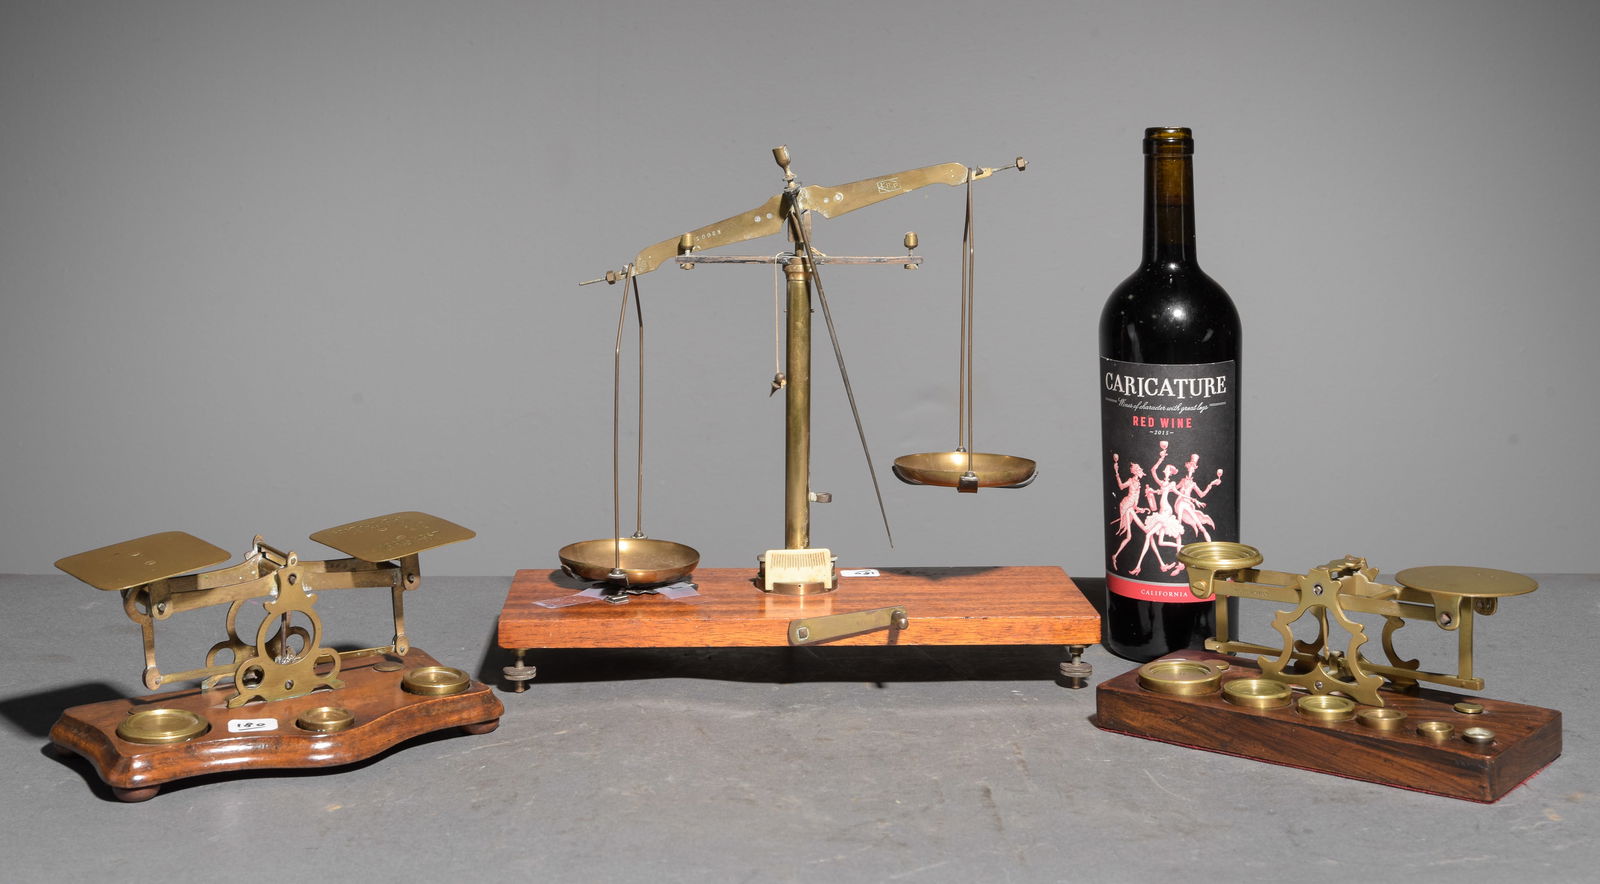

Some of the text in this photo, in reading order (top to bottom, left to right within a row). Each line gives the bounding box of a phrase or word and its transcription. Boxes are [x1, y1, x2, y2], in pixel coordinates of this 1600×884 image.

[1105, 372, 1227, 399] CARICATURE
[1117, 398, 1133, 409] Wines
[1138, 401, 1166, 411] character
[1166, 402, 1182, 412] with
[1178, 403, 1197, 414] great
[1132, 415, 1193, 429] RED WINE
[1140, 589, 1188, 597] CALIFORNIA
